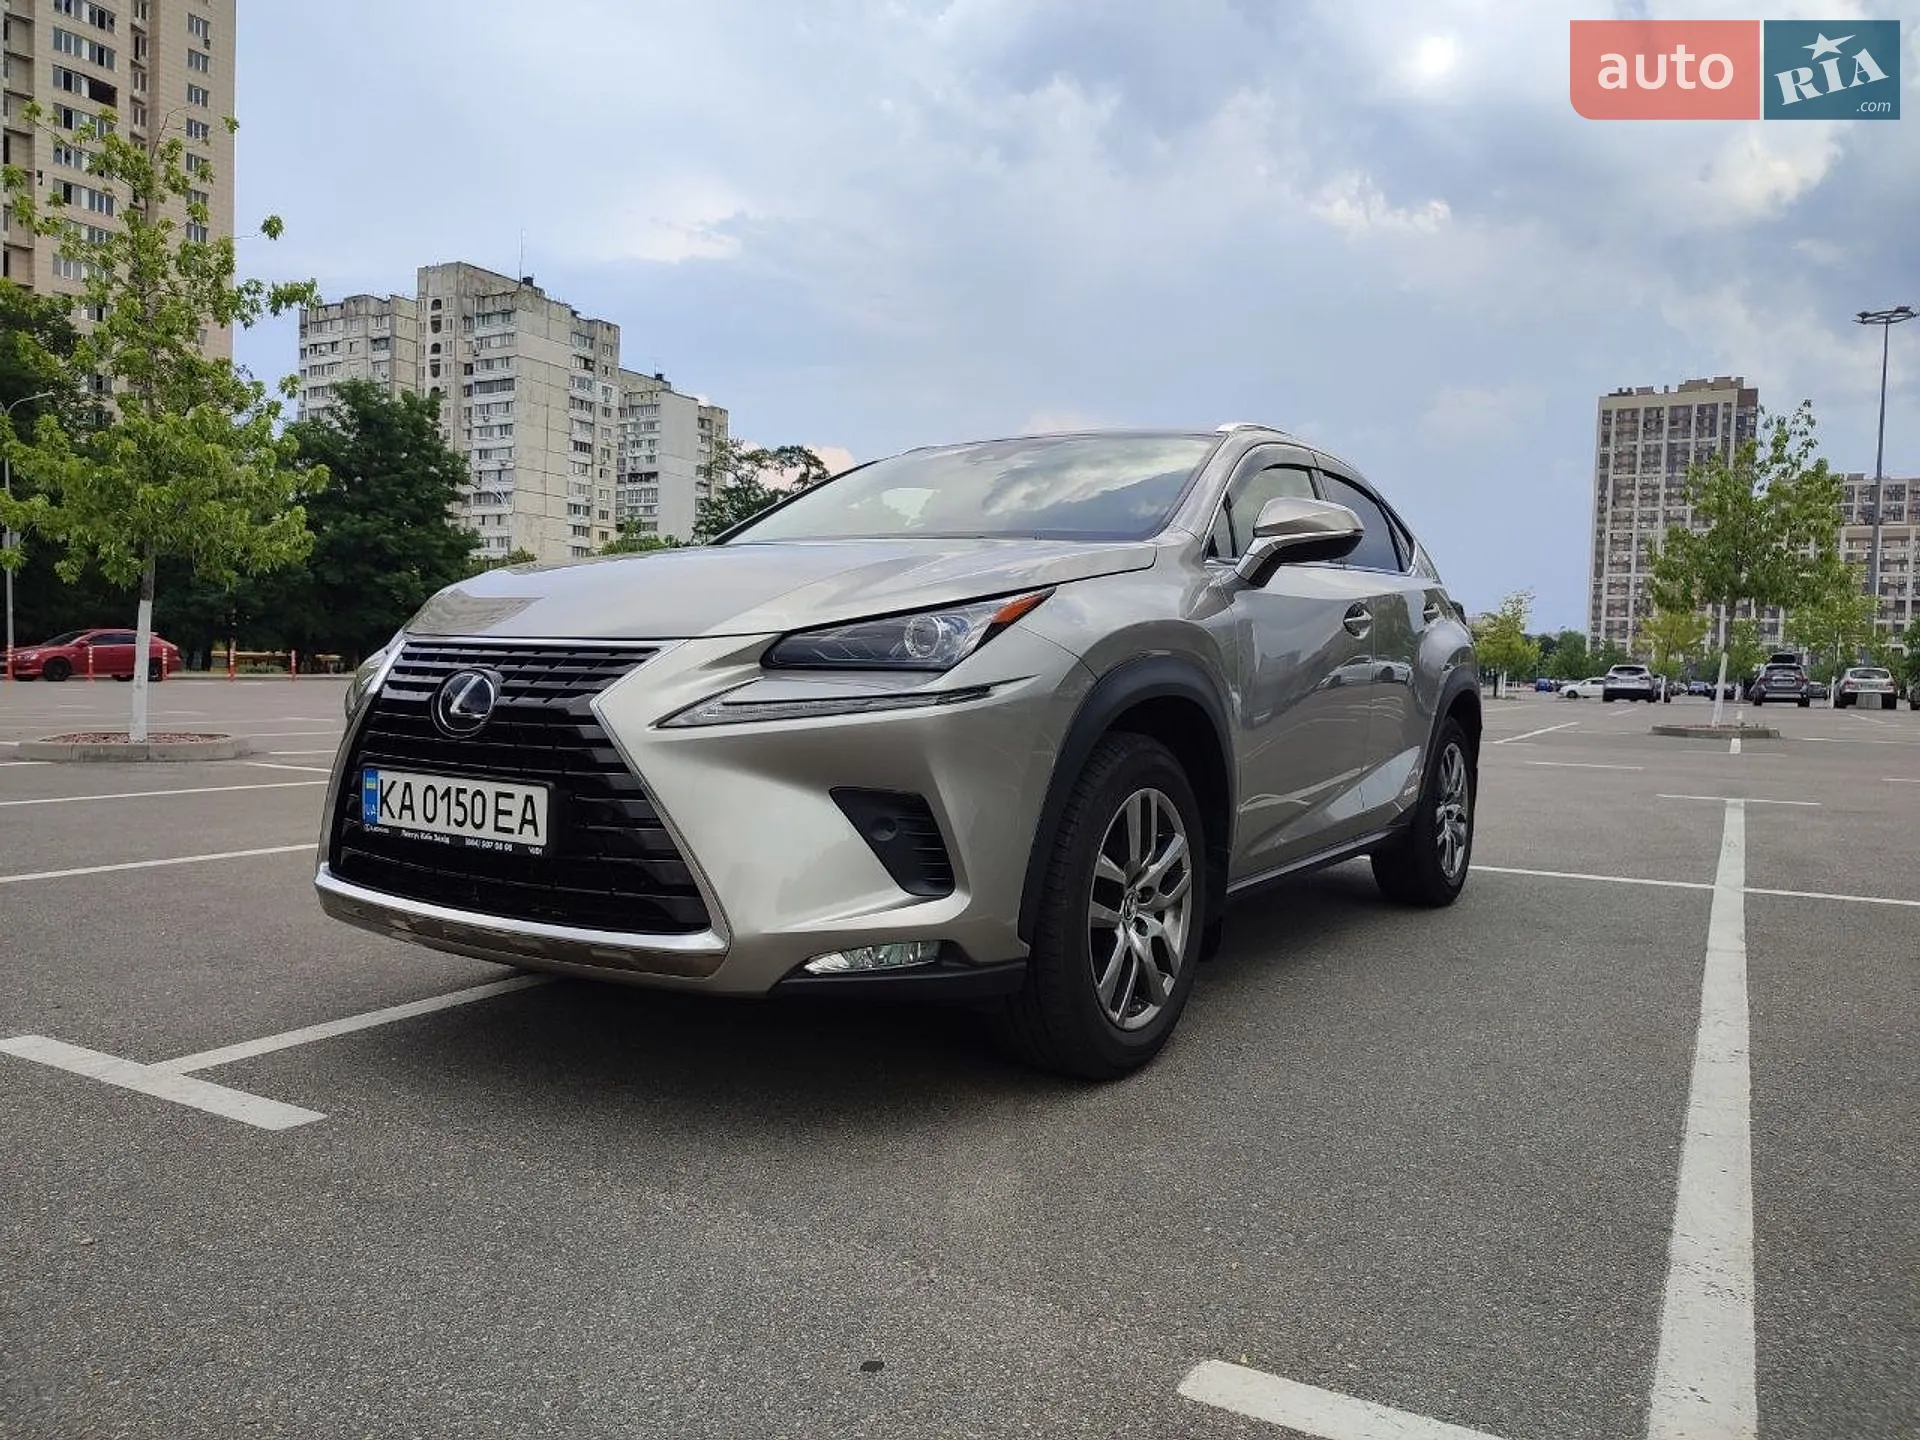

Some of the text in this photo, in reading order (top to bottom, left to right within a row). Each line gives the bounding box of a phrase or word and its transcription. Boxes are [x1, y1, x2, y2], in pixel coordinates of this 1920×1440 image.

[379, 778, 540, 837] KA 0150 EA
